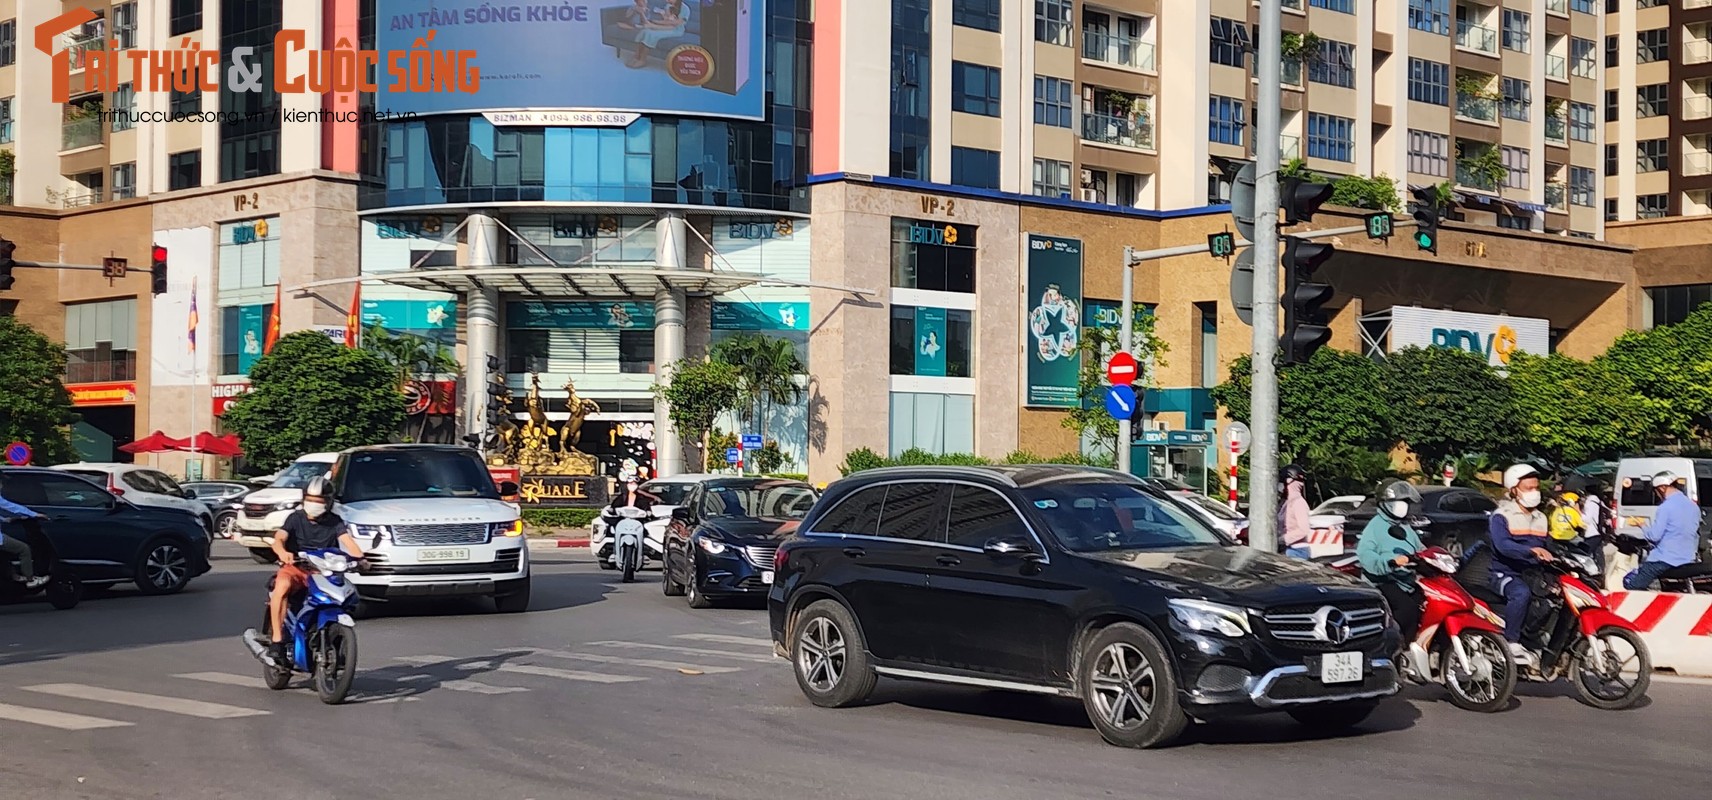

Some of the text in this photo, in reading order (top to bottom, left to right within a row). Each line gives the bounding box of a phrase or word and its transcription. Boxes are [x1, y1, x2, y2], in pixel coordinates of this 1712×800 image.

[390, 15, 414, 31] AN
[493, 114, 532, 122] BIZMAN
[233, 193, 259, 212] VP-2
[920, 195, 955, 217] VP-2
[910, 225, 945, 246] BIDV
